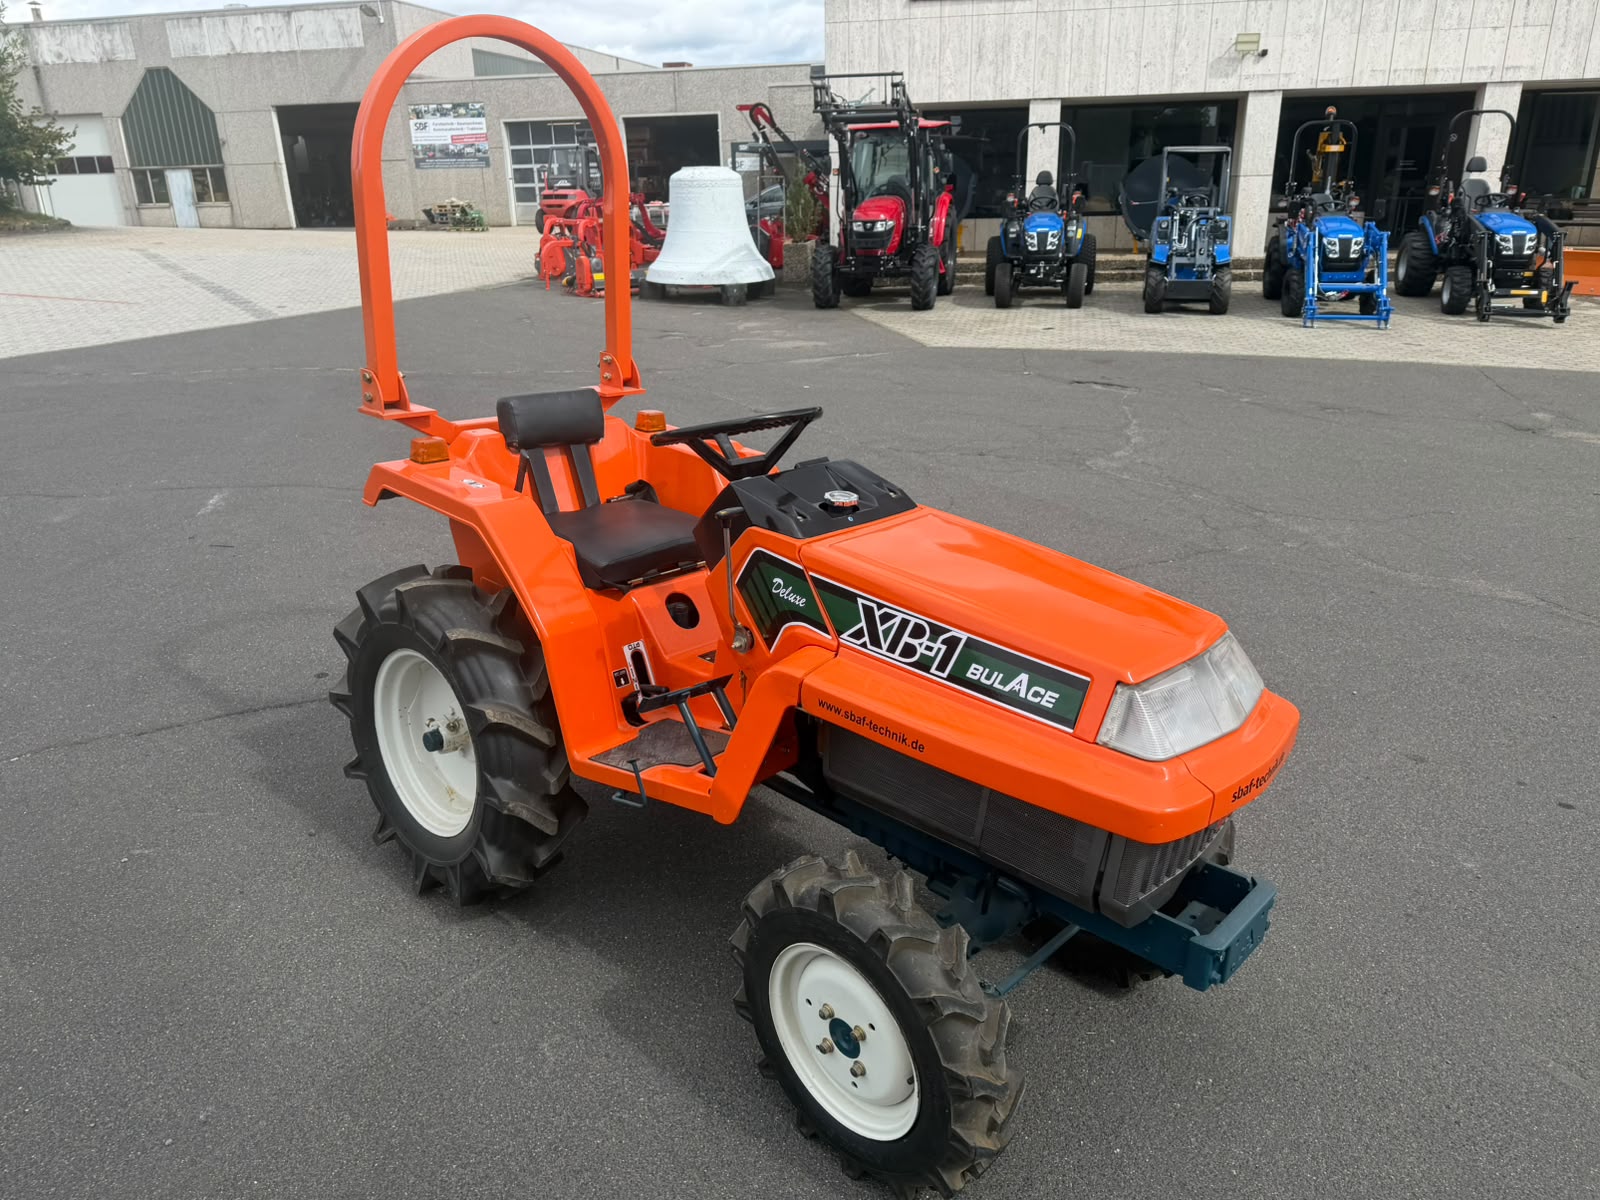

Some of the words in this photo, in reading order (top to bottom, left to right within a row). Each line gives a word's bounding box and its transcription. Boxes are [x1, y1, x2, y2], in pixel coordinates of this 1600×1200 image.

[772, 577, 807, 607] Deluxe
[840, 597, 968, 678] XB-1
[966, 663, 1060, 709] BULACE
[818, 698, 925, 753] www.sbaf-technik.de
